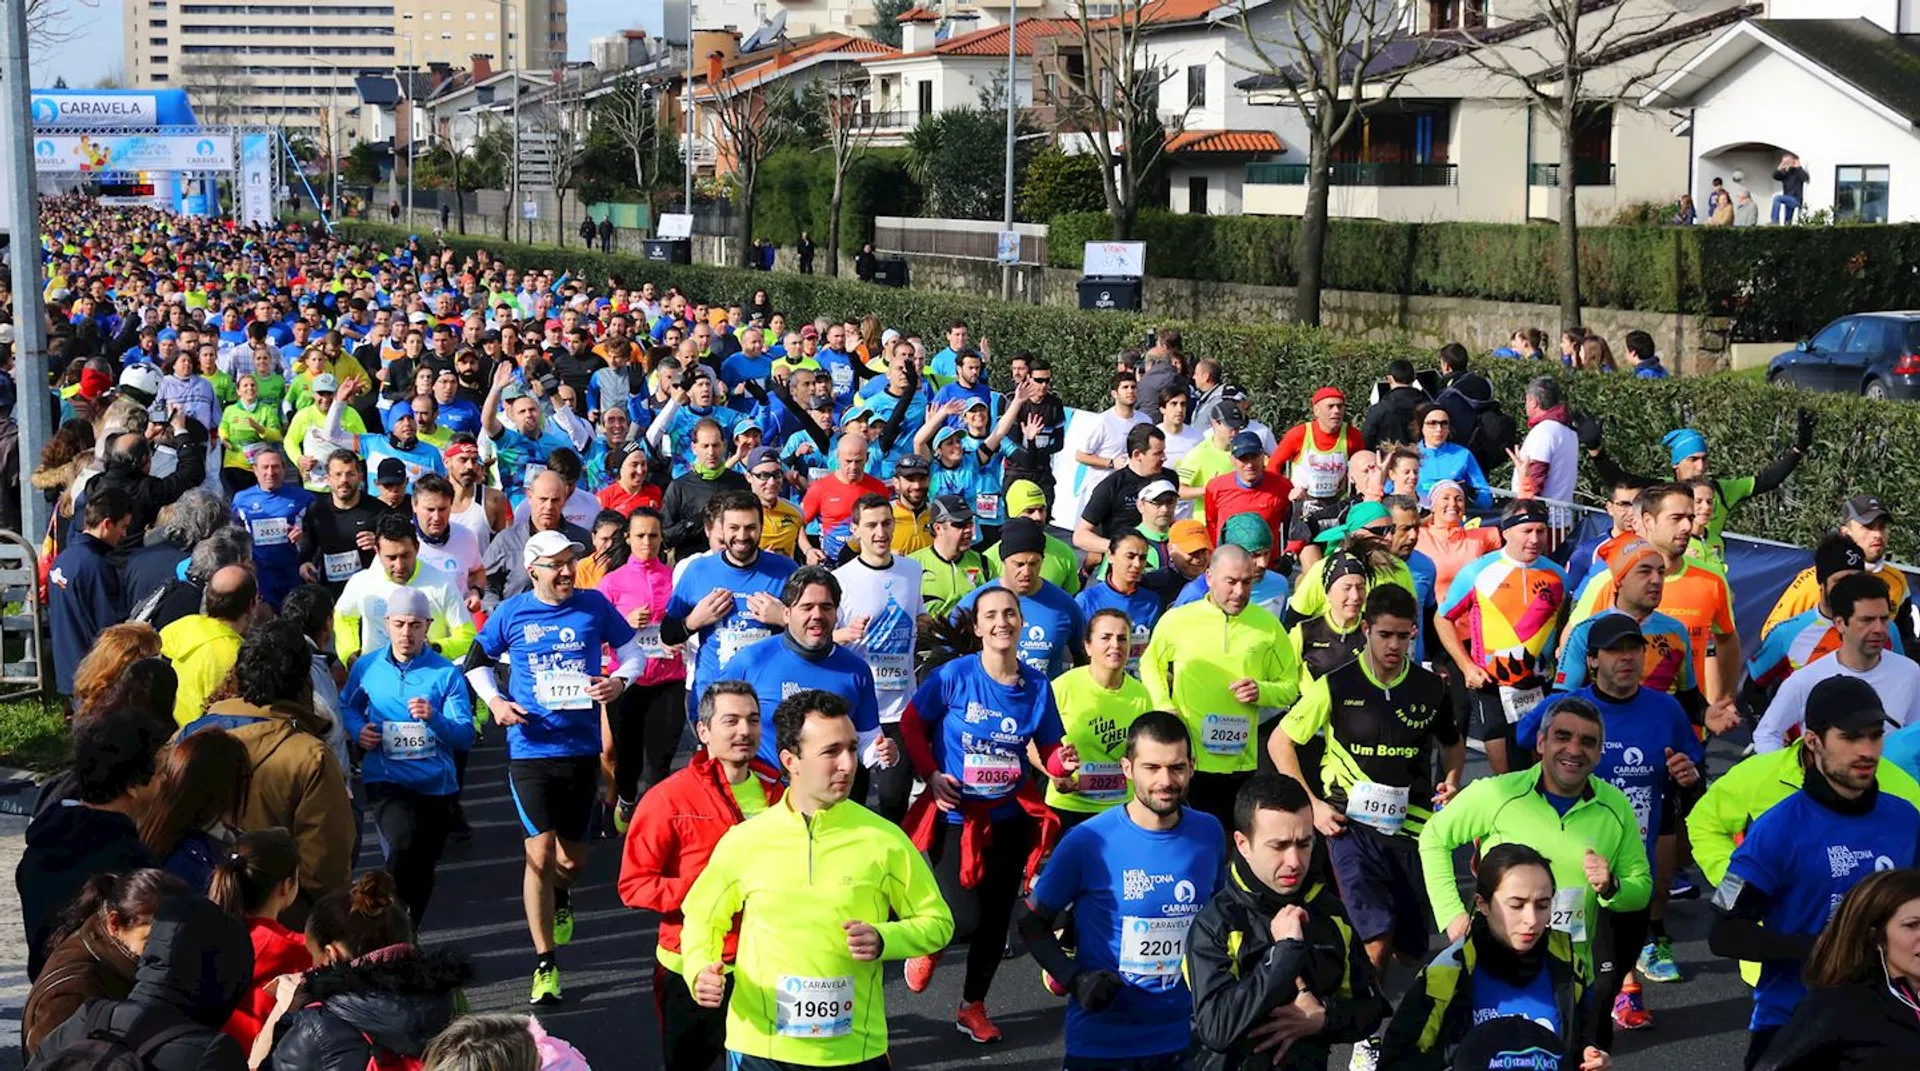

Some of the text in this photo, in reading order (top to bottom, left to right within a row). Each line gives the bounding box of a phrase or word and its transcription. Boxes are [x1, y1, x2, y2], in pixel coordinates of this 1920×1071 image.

[60, 102, 141, 114] CARAVELA
[1020, 640, 1053, 649] CARAVELA
[876, 666, 902, 678] 1075
[550, 685, 580, 697] 1717
[1094, 718, 1116, 736] LUA
[1211, 729, 1240, 741] 2024
[394, 736, 426, 748] 2165
[1350, 743, 1419, 759] Um Bongo
[1613, 765, 1655, 775] CARAVELA
[976, 770, 1011, 783] 2036
[1363, 799, 1397, 816] 1916
[1150, 920, 1191, 930] CARAVELA
[1140, 940, 1181, 957] 2201
[803, 979, 848, 990] CARAVELA
[794, 1000, 840, 1019] 1969
